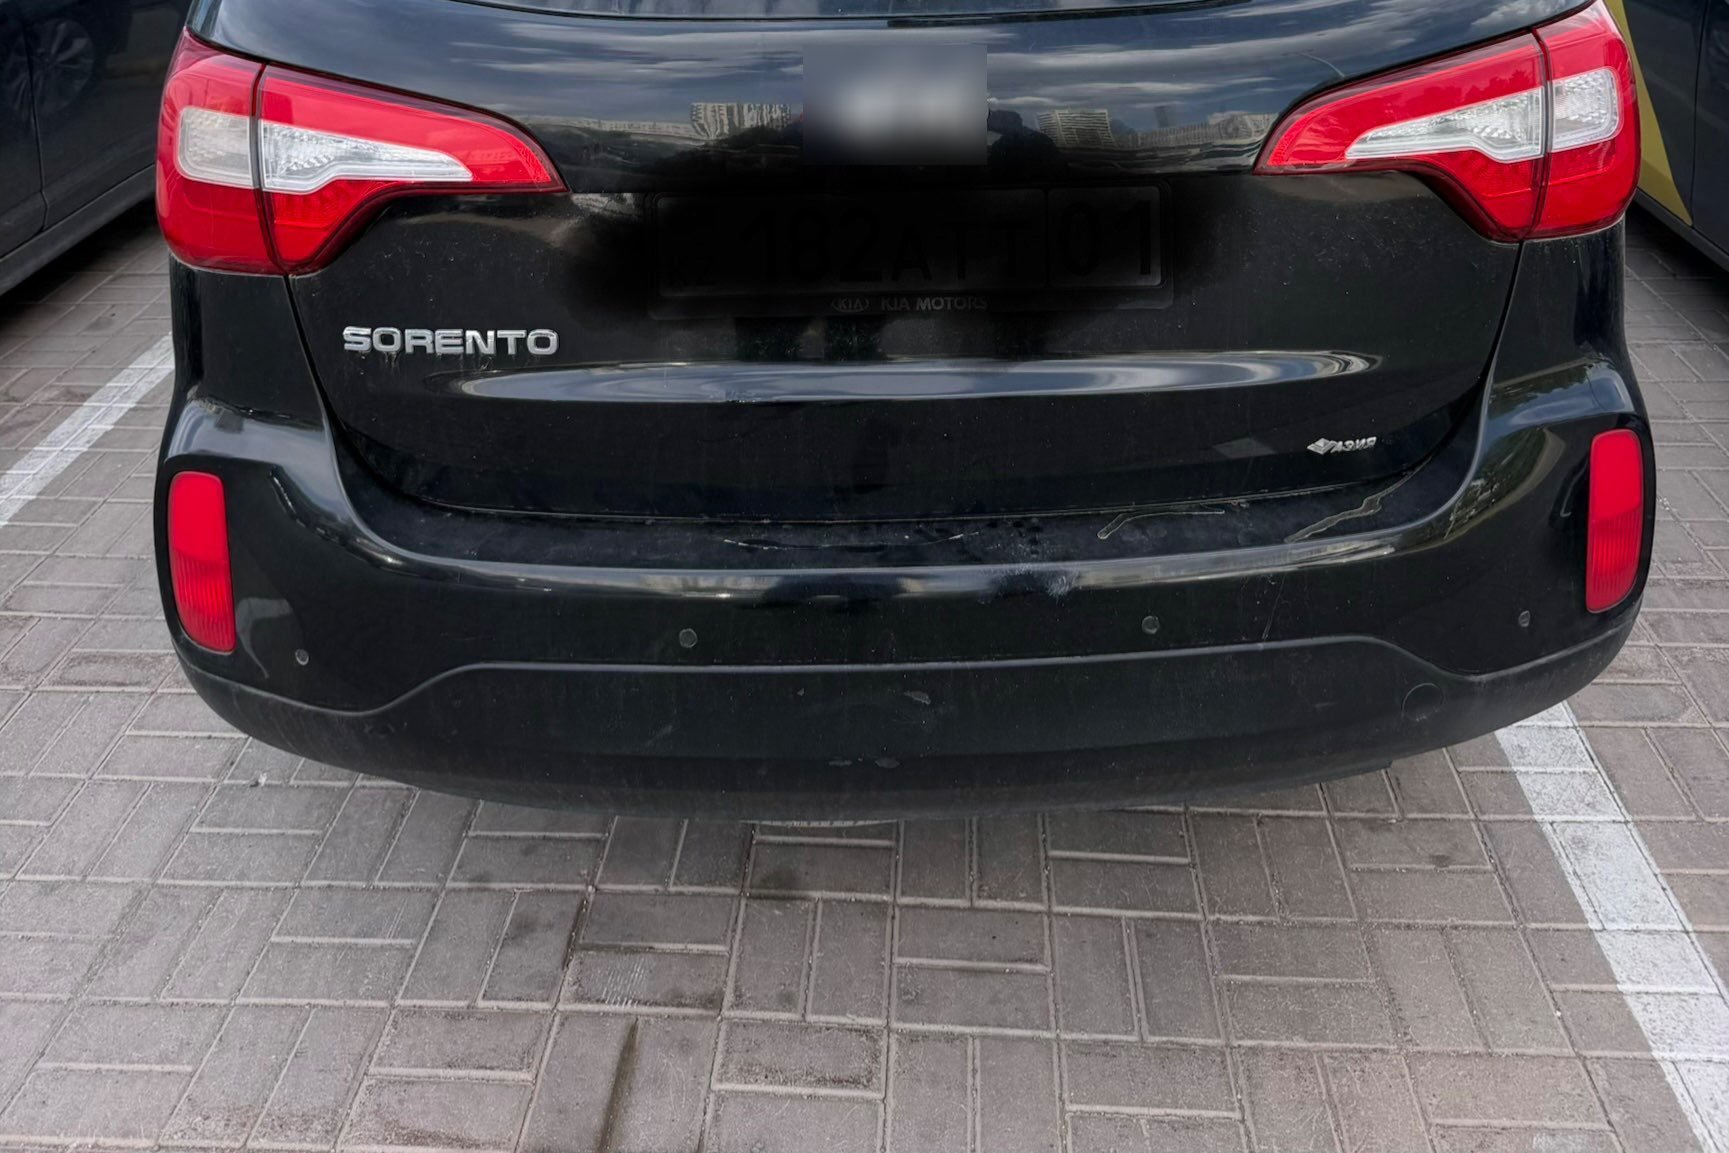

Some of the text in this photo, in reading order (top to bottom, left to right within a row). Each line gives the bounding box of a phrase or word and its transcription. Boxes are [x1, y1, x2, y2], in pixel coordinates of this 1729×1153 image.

[881, 296, 988, 311] KIA MOTORS
[342, 326, 559, 356] SORENTO
